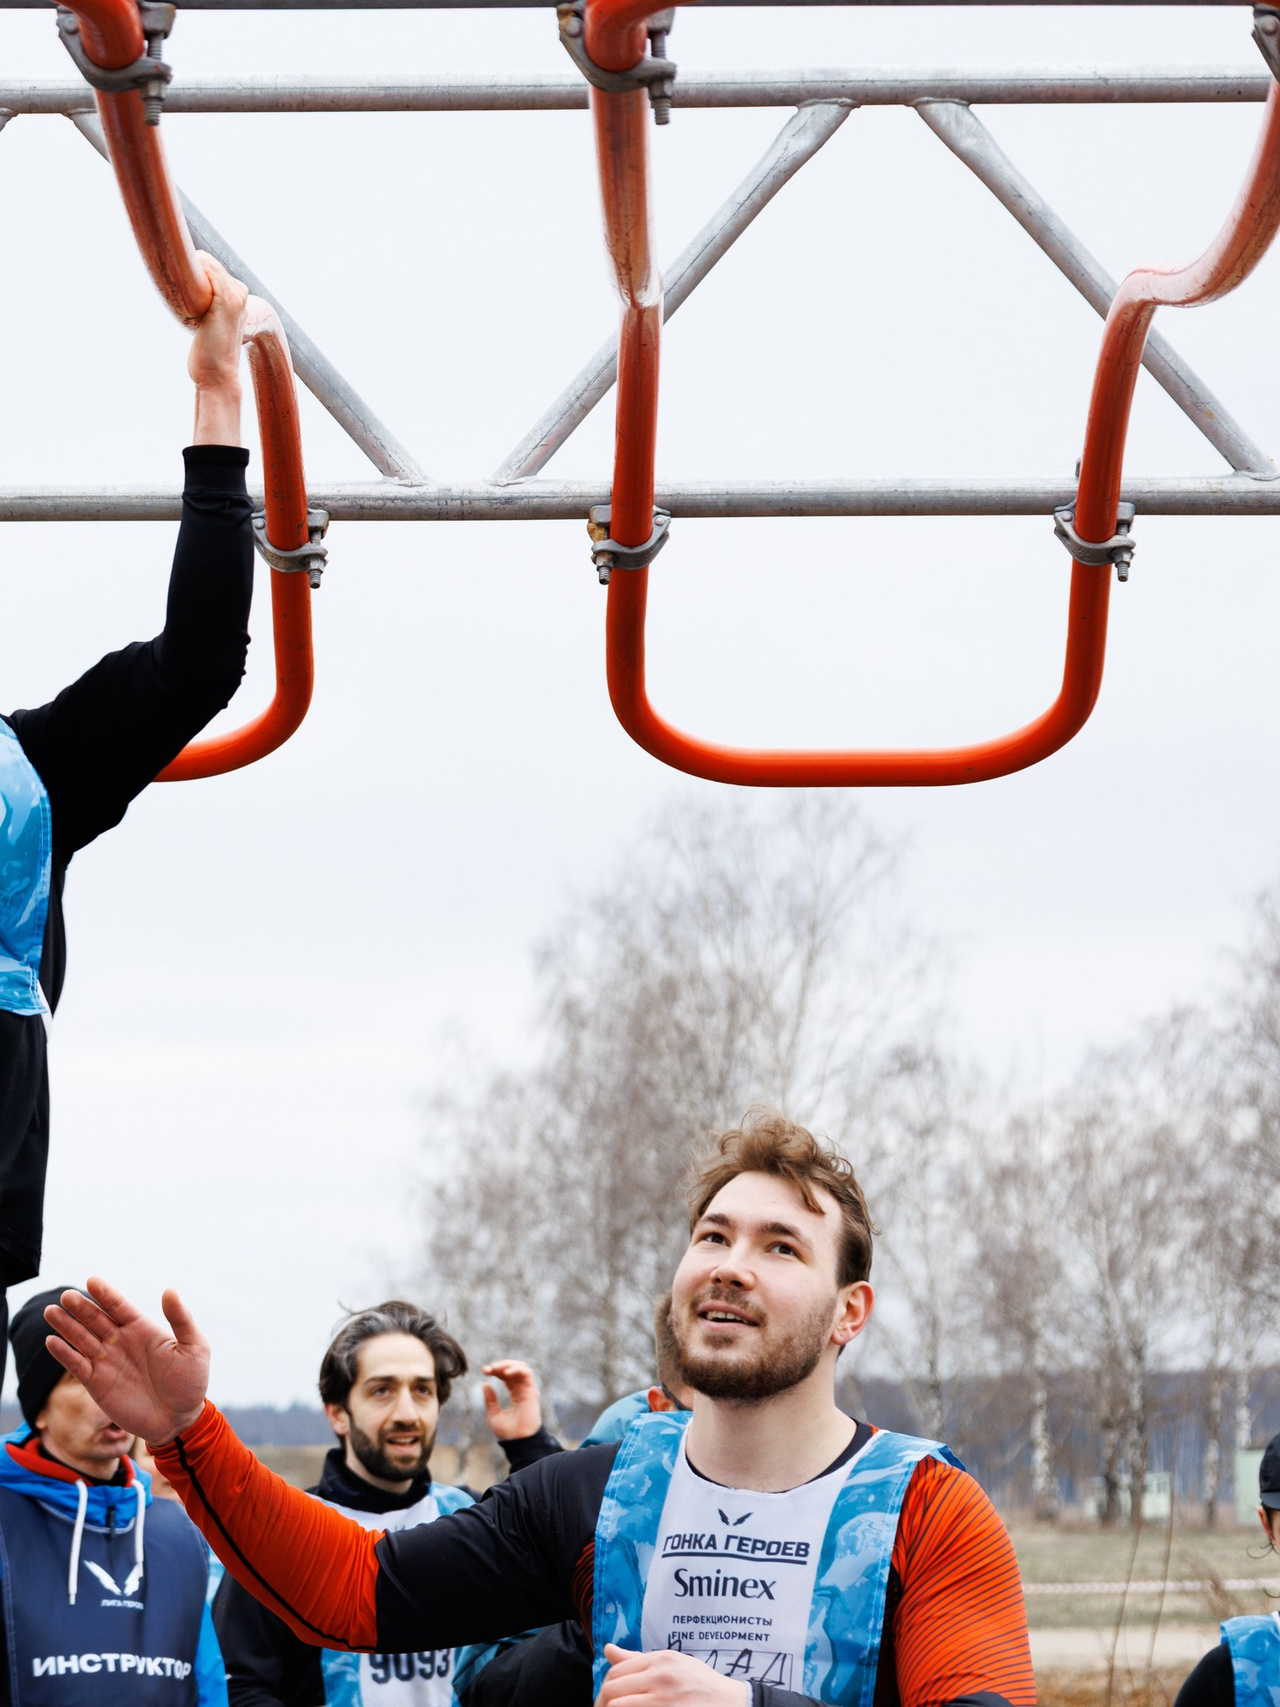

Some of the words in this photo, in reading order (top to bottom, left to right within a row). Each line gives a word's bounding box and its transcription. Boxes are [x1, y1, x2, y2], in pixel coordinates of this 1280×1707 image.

[663, 1533, 718, 1552] ГОНКА
[724, 1534, 811, 1558] ГЕРОЕВ
[674, 1568, 777, 1600] Sminex
[672, 1615, 773, 1627] ПЕРФЕКЦИОНИСТЫ
[671, 1631, 695, 1640] FINE
[698, 1631, 770, 1642] DEVELOPMENT
[32, 1653, 192, 1680] ИНСТРУКТОР
[368, 1649, 451, 1685] 9093
